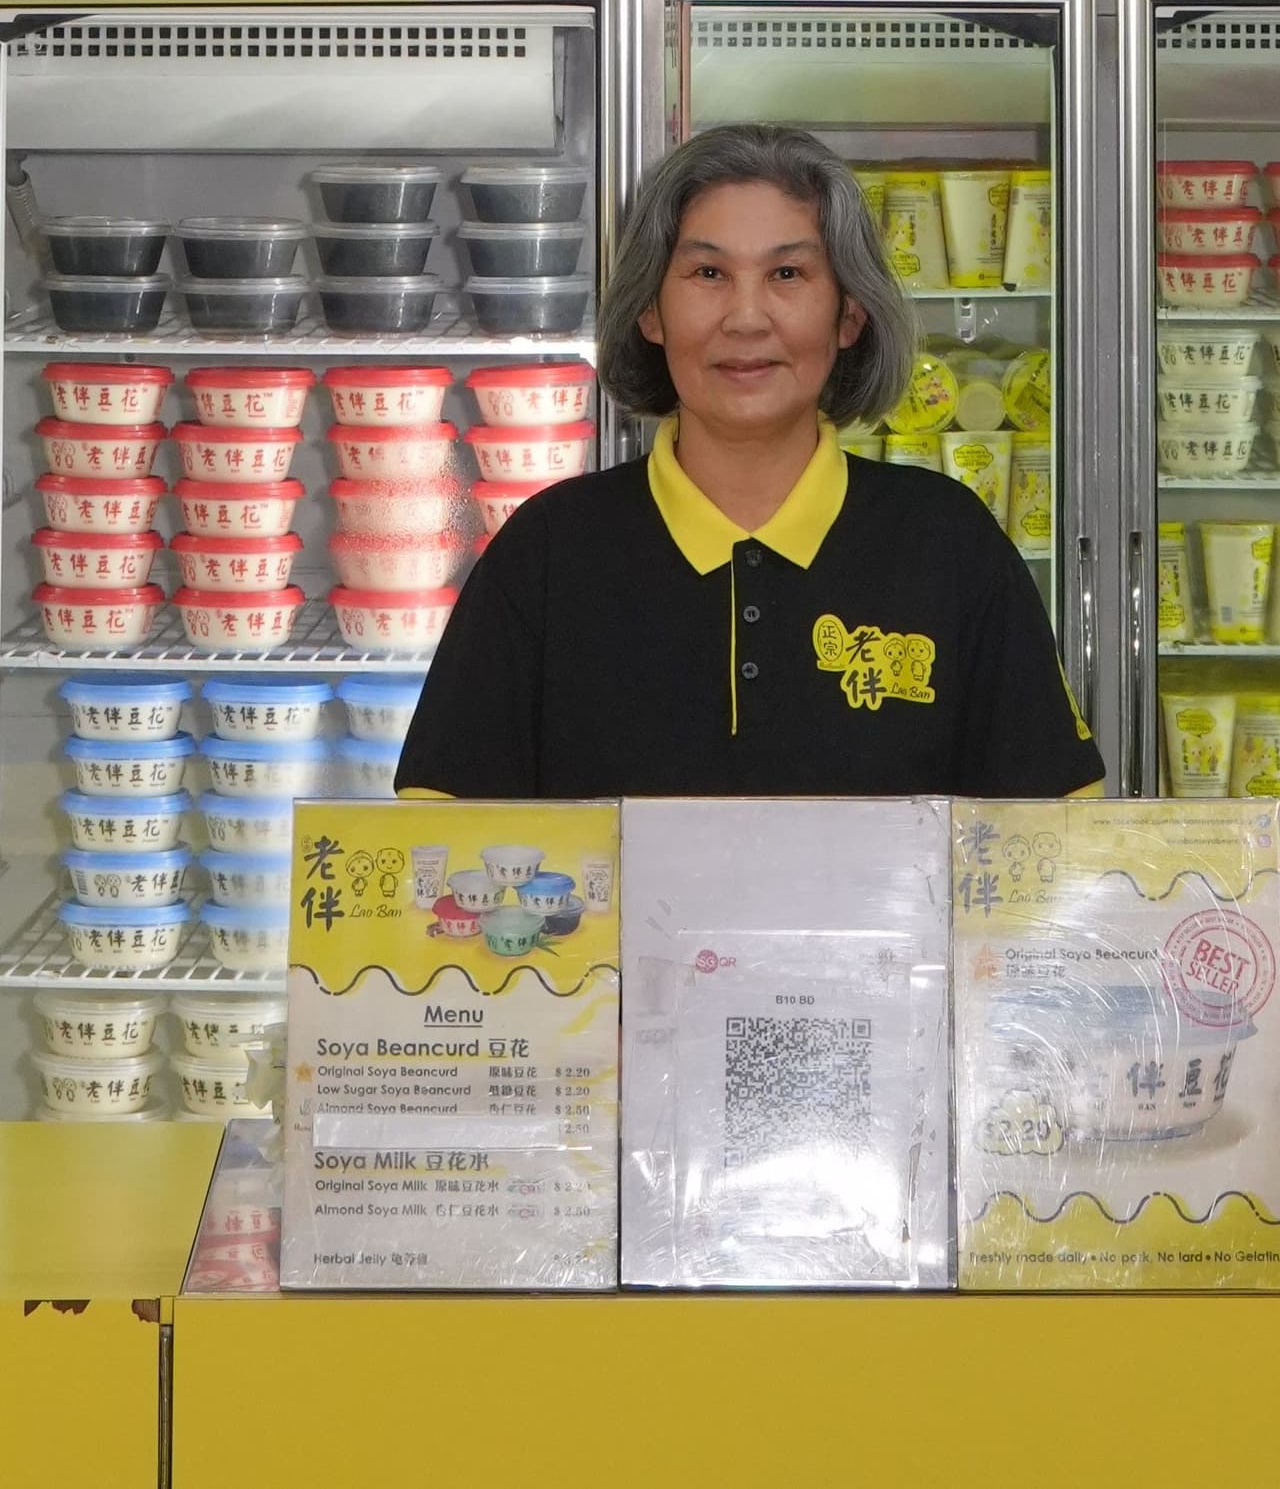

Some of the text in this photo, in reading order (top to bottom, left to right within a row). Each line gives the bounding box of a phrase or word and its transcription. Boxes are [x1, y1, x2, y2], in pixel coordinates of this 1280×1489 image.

[846, 630, 888, 706] 老伴
[300, 835, 345, 933] 老伴
[1193, 939, 1250, 980] BEST
[776, 995, 815, 1005] B10 BD
[424, 1006, 483, 1023] Menu
[317, 1038, 529, 1060] Soya Beancurd 豆花
[318, 1066, 364, 1078] Original
[368, 1066, 396, 1079] Soya
[401, 1066, 458, 1078] Beancurd
[318, 1084, 471, 1097] Low Sugar Soya Beancurd
[314, 1152, 366, 1174] Soya
[374, 1152, 416, 1170] Milk
